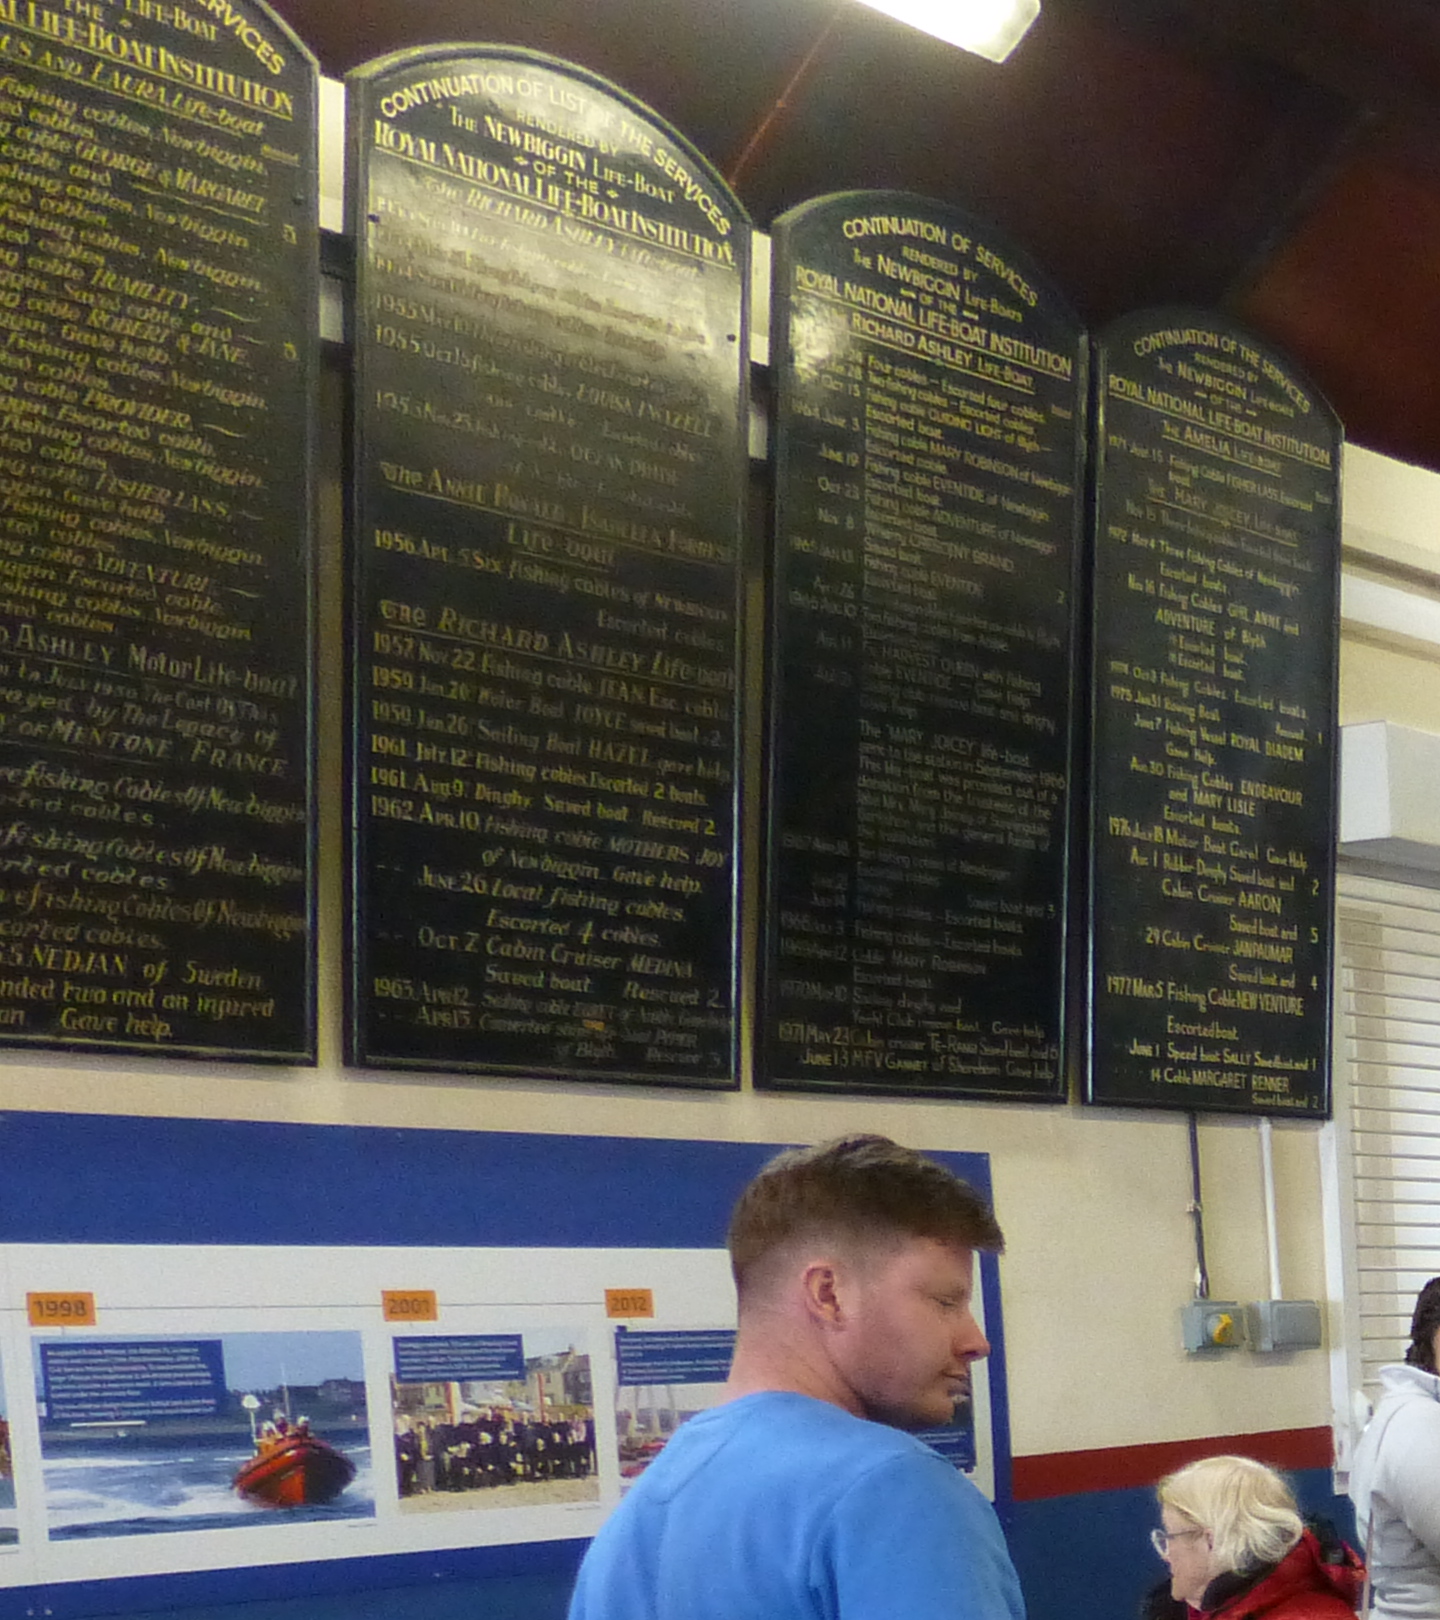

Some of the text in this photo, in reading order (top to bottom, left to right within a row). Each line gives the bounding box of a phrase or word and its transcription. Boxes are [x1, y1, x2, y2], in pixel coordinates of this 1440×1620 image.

[159, 46, 294, 116] INSTITUTION
[374, 118, 438, 159] ROYAL
[441, 142, 533, 197] NATIONAL
[380, 73, 514, 119] CONTINUATION
[516, 78, 544, 97] OF
[618, 120, 652, 156] THE
[652, 146, 734, 237] SERVICES
[484, 114, 587, 172] NEWBIGGIN
[841, 214, 1039, 308] CONTINUATION OF SERVICES
[876, 253, 961, 300] NEWBIGGIN
[795, 264, 842, 297] ROYAL
[843, 280, 915, 324] NATIONAL
[988, 332, 1073, 378] INSTITUTION
[852, 312, 915, 347] RICHARD
[917, 333, 975, 368] ASHLEY
[1132, 327, 1219, 358] CONTINUATION
[1107, 373, 1145, 401] ROYAL
[1147, 385, 1207, 423] NATIONAL
[1177, 359, 1248, 401] NEWBIGGIN
[1184, 426, 1232, 457] AMELIA
[1237, 890, 1283, 918] AARON
[181, 958, 264, 992] Sweden
[33, 1300, 87, 1318] 1998
